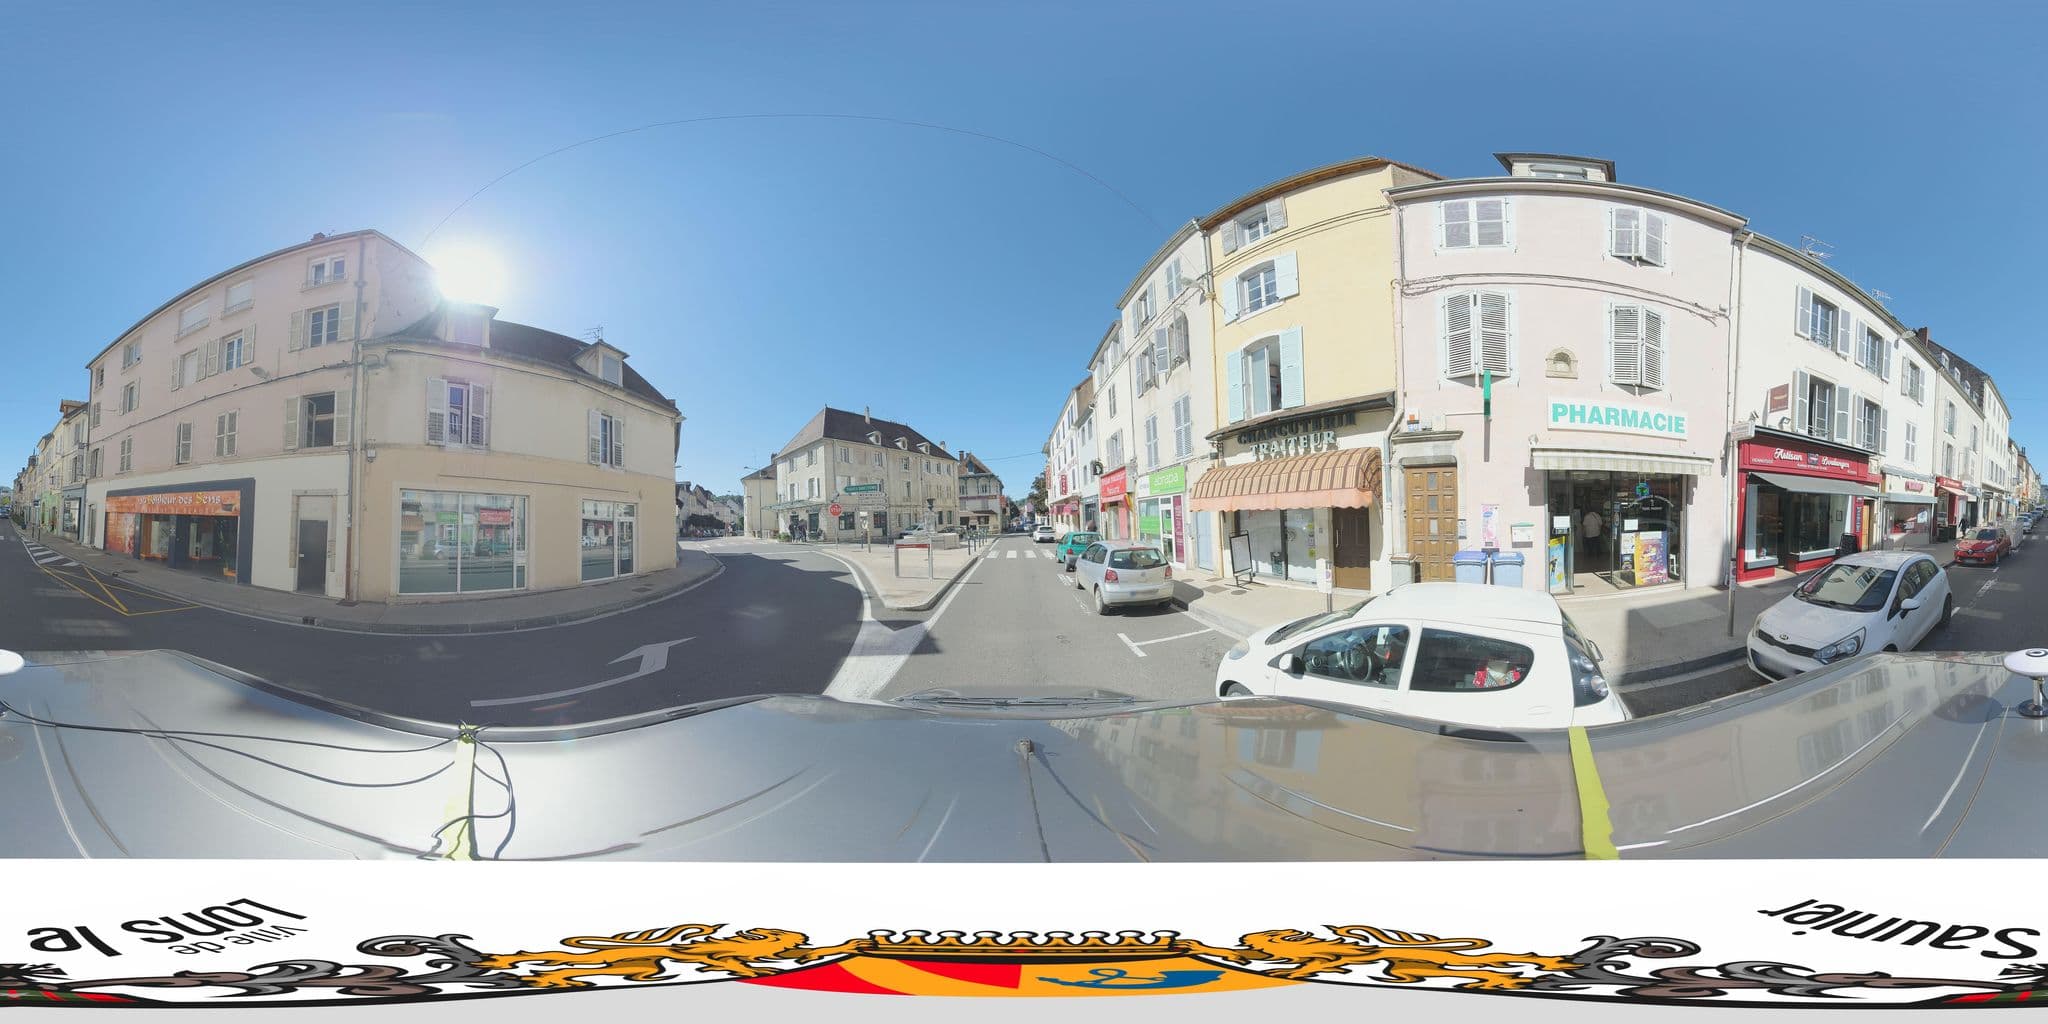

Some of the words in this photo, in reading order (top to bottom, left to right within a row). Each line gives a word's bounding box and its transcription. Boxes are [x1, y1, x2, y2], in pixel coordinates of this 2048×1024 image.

[1551, 403, 1685, 433] PHARMACIE
[1250, 431, 1336, 457] TRAITEUR
[1774, 448, 1803, 462] Artisan
[177, 495, 192, 504] des
[195, 492, 220, 504] Sens
